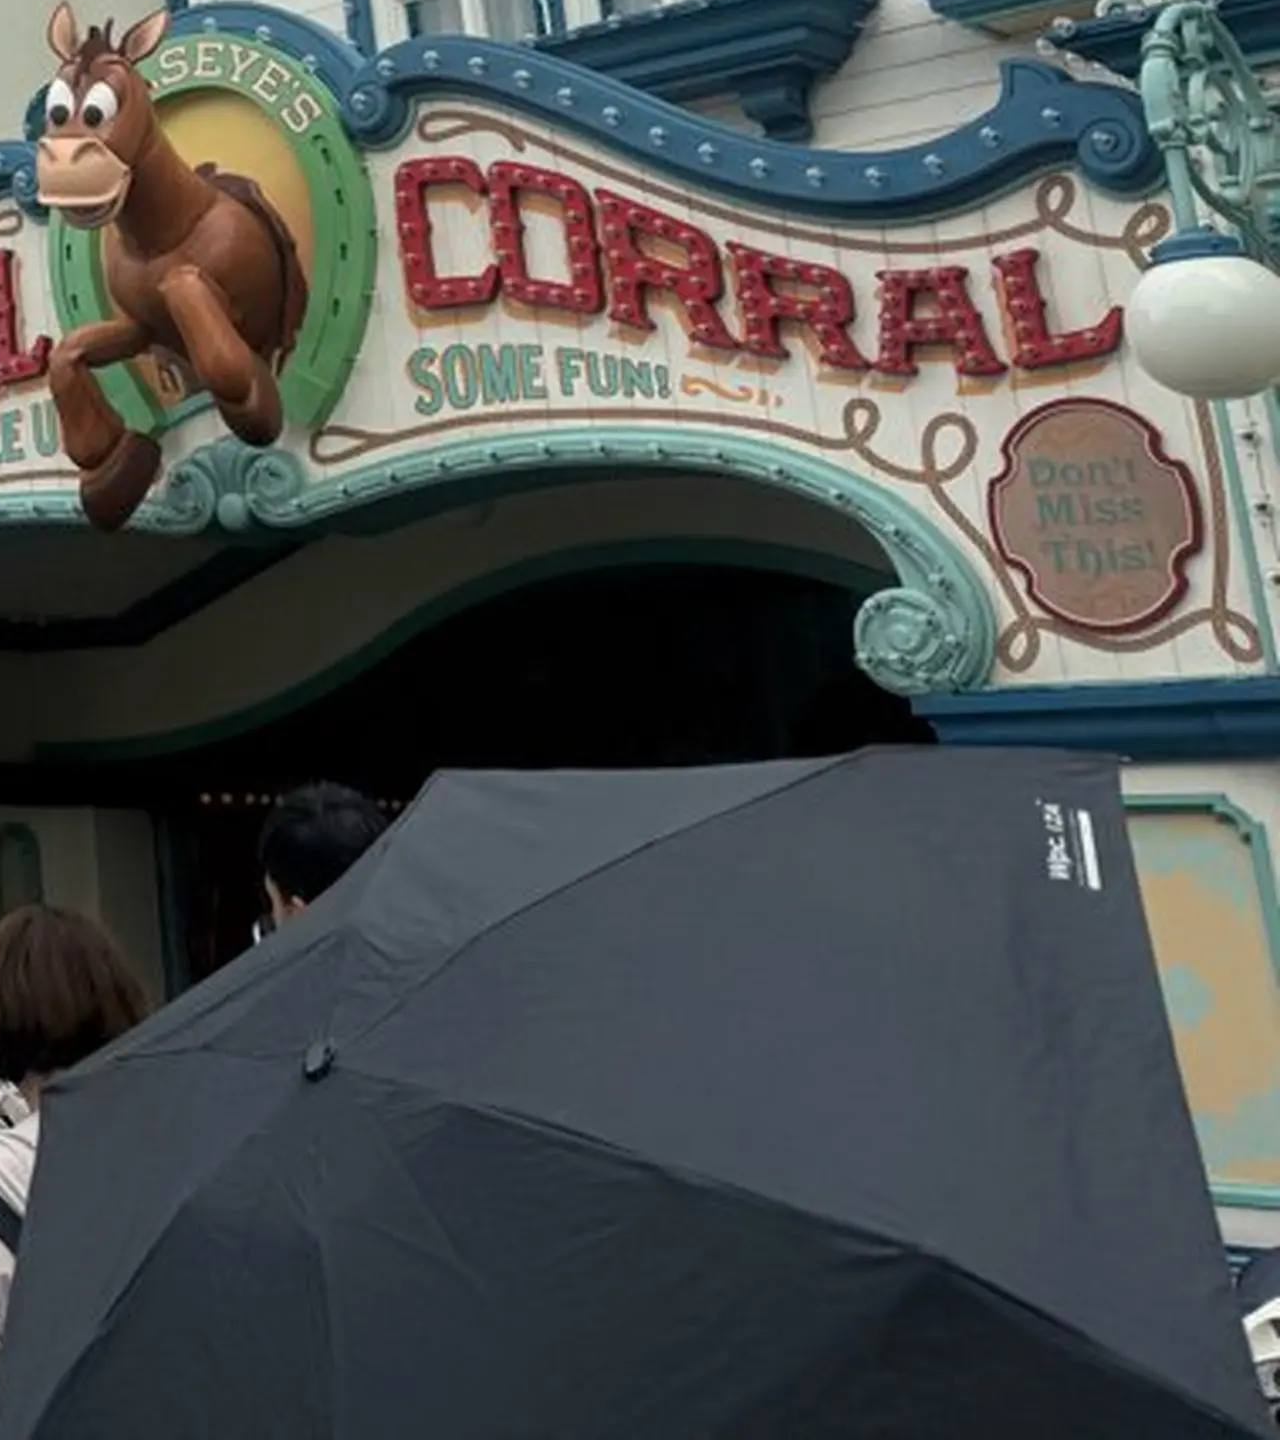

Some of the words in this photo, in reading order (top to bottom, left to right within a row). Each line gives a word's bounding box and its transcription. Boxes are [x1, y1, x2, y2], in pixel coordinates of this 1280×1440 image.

[145, 40, 323, 134] SEYE'S
[396, 156, 1126, 378] CORRAL
[407, 343, 547, 416] SOME
[557, 346, 673, 400] FUN!
[30, 398, 60, 457] U
[1028, 457, 1139, 487] Don't
[1037, 493, 1144, 526] Miss
